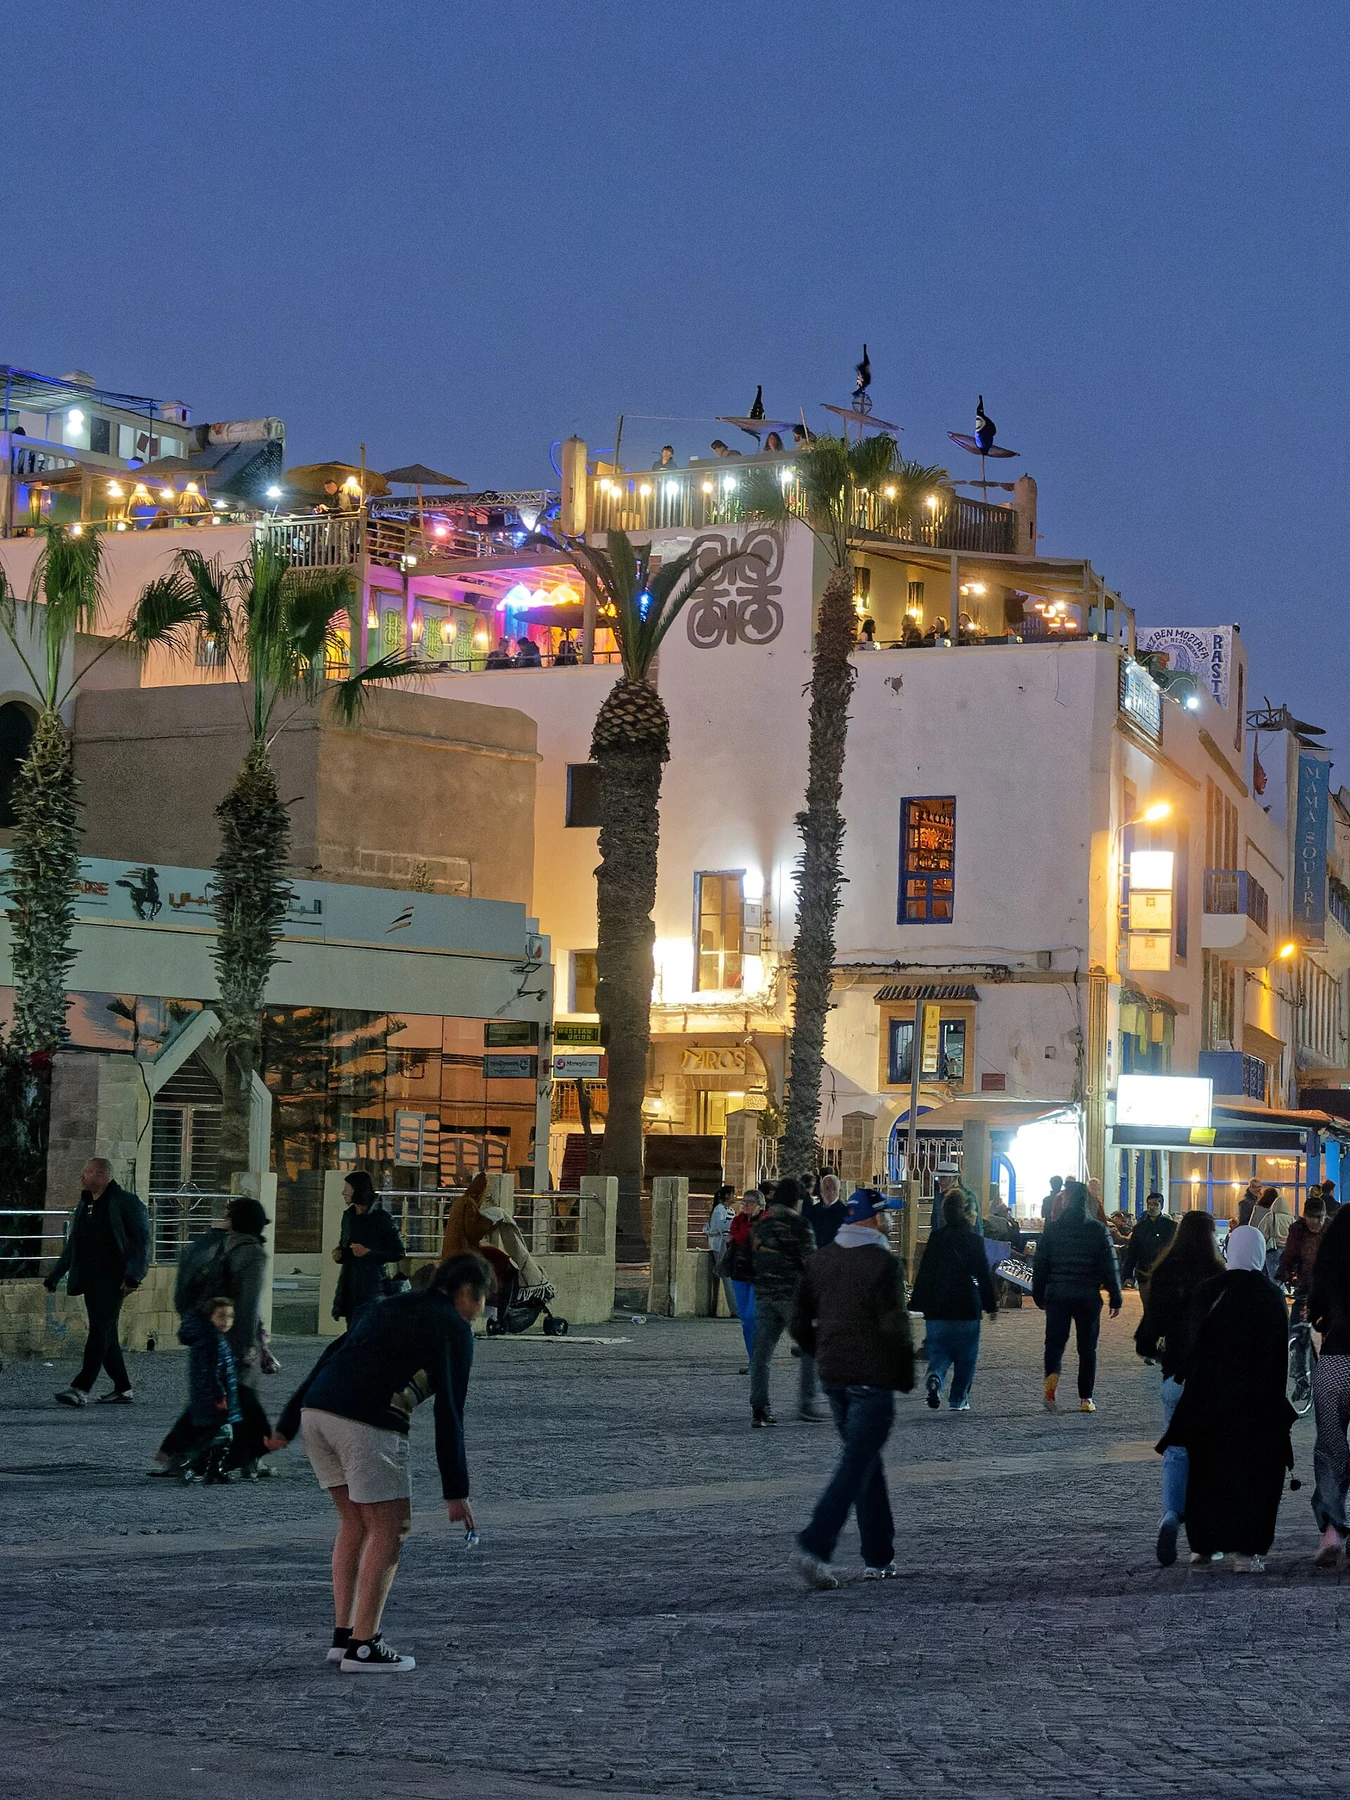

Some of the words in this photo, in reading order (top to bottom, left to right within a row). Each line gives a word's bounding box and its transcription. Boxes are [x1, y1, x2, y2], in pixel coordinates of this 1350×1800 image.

[1153, 629, 1173, 641] BEN
[1305, 765, 1321, 823] MAMA
[1302, 830, 1317, 919] SOUIRI
